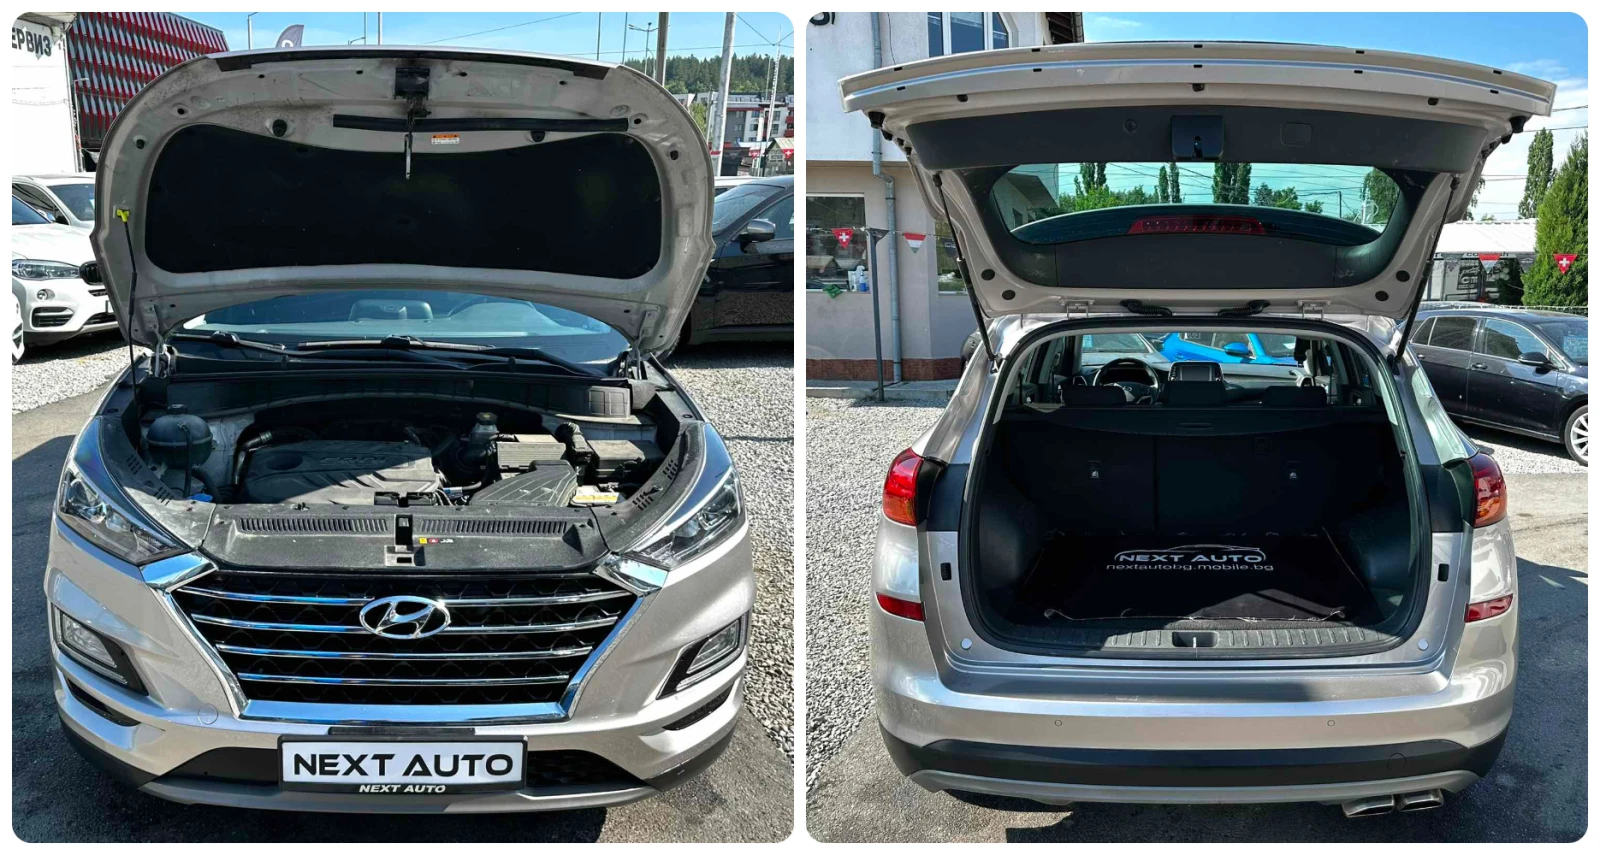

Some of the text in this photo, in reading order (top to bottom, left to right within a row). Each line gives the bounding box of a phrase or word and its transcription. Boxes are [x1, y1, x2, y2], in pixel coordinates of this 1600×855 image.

[1119, 554, 1262, 563] NEXT AUTO
[1106, 563, 1274, 571] nextautobg.mobile.bg
[294, 753, 513, 777] NEXT AUTO
[359, 784, 447, 793] NEXT AUTO
